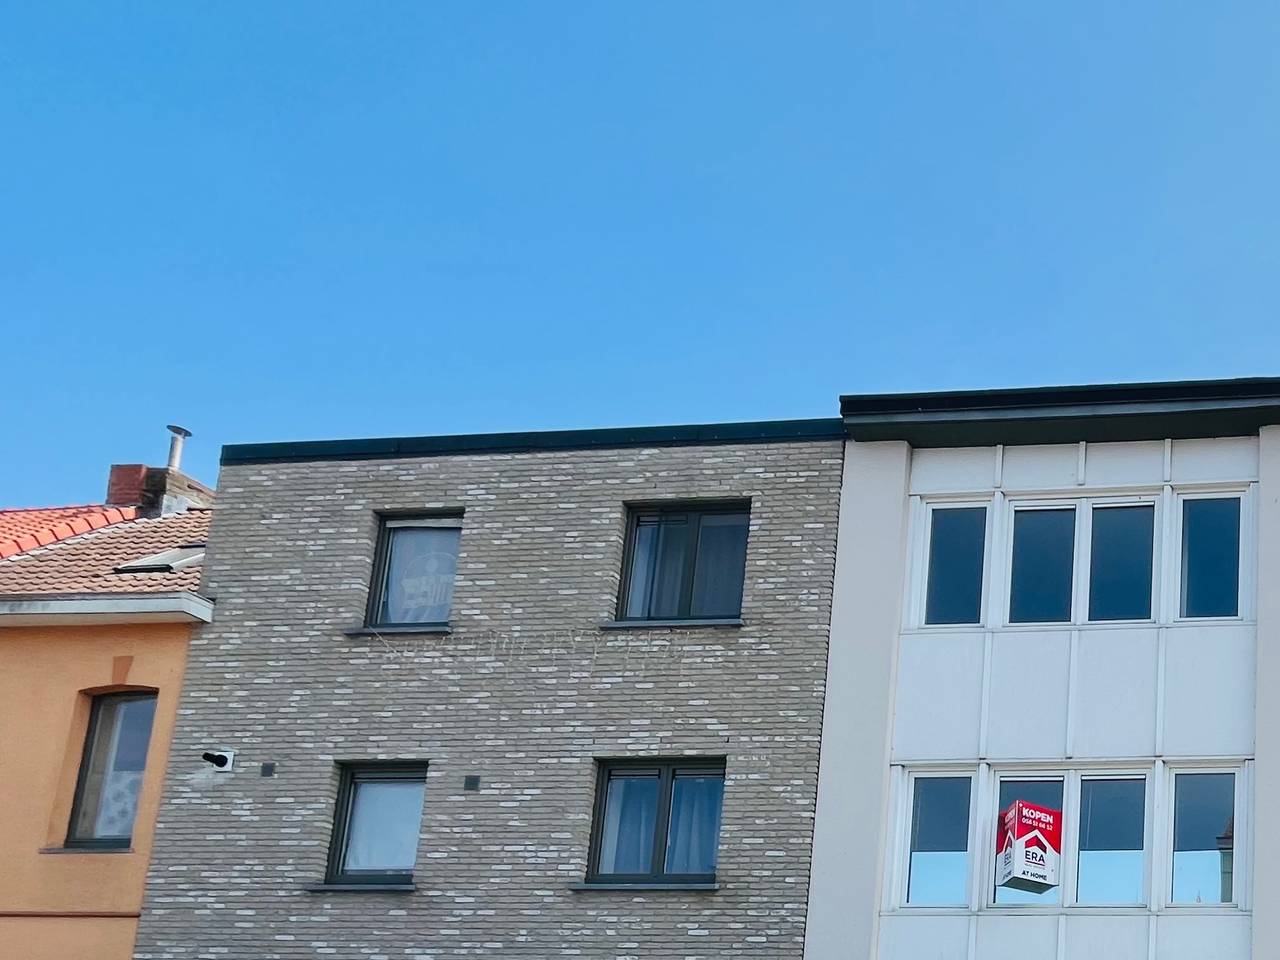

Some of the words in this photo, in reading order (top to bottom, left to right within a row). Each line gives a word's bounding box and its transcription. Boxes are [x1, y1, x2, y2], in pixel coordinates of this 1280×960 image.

[1022, 807, 1053, 824] KOPEN
[1025, 850, 1045, 864] ERA
[1030, 872, 1047, 881] HOME
